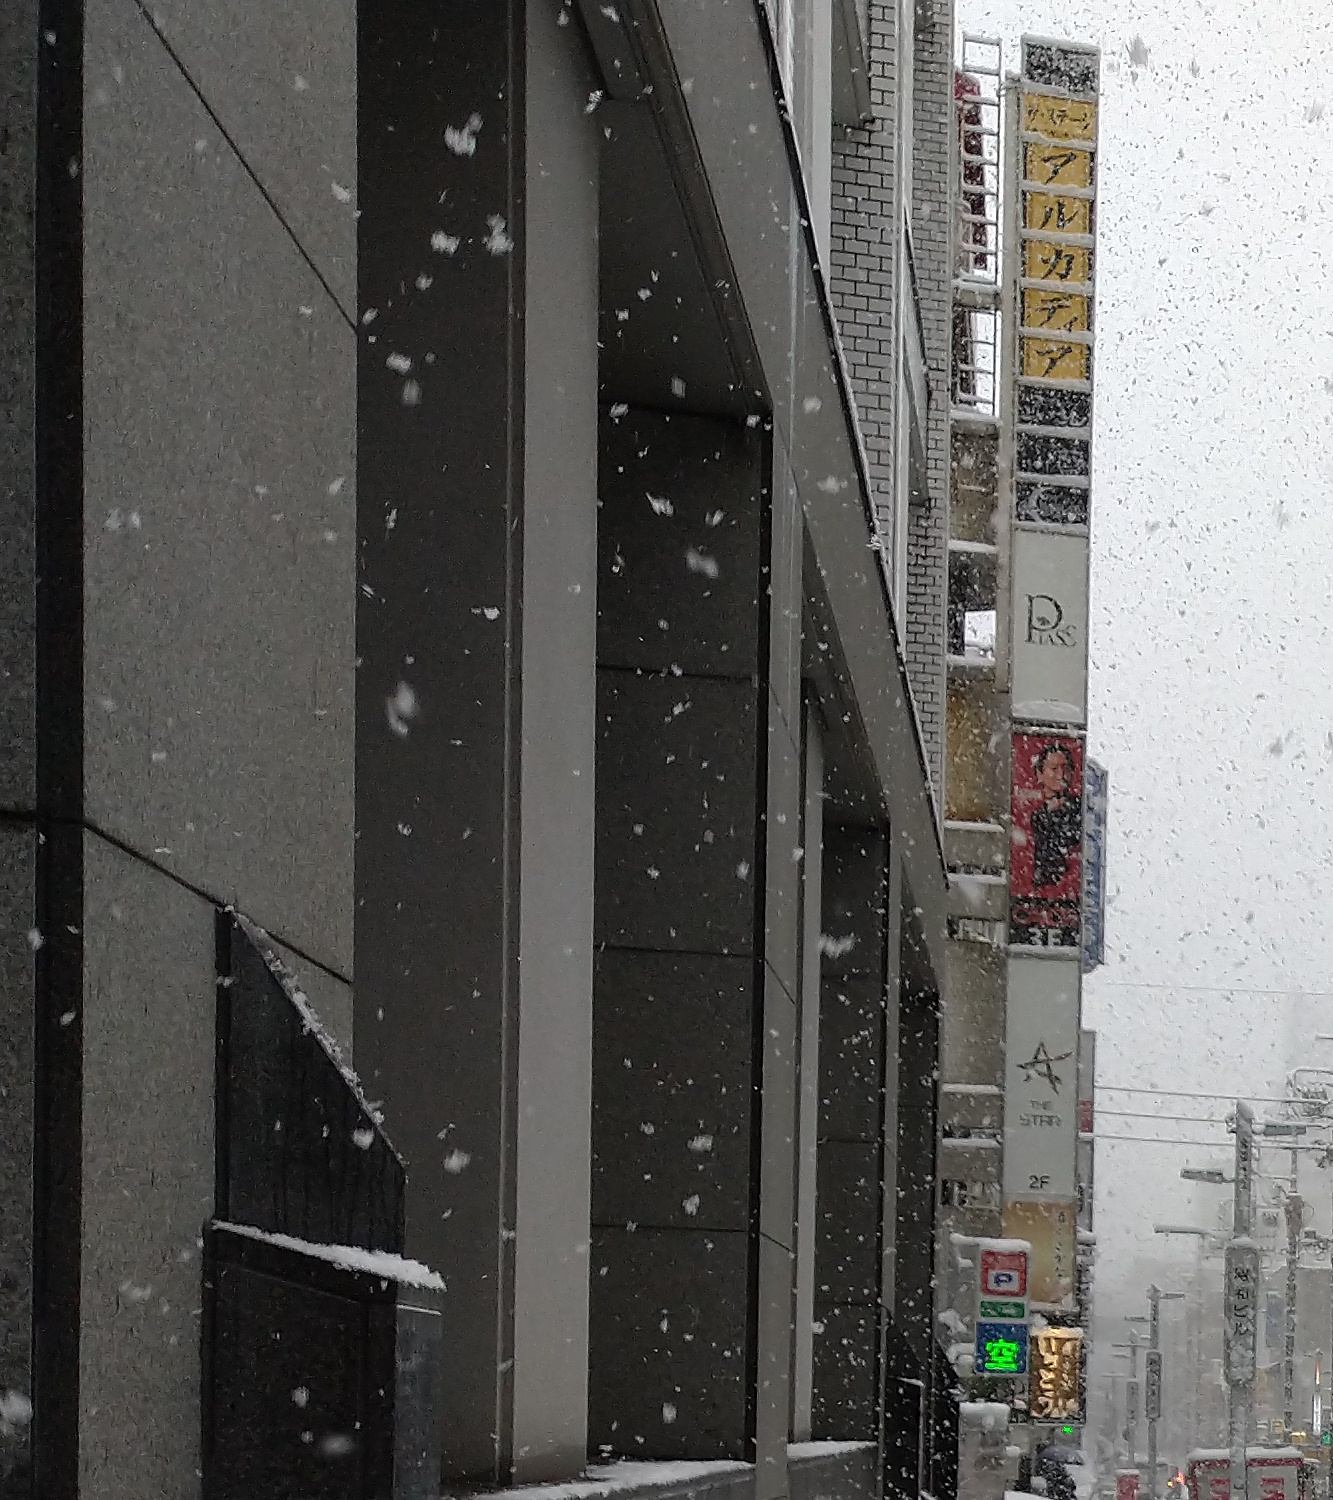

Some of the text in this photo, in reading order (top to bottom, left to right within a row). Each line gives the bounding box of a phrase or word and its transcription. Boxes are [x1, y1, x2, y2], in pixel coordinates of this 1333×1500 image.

[1032, 149, 1081, 378] アルカディア
[1029, 1174, 1051, 1189] 2F
